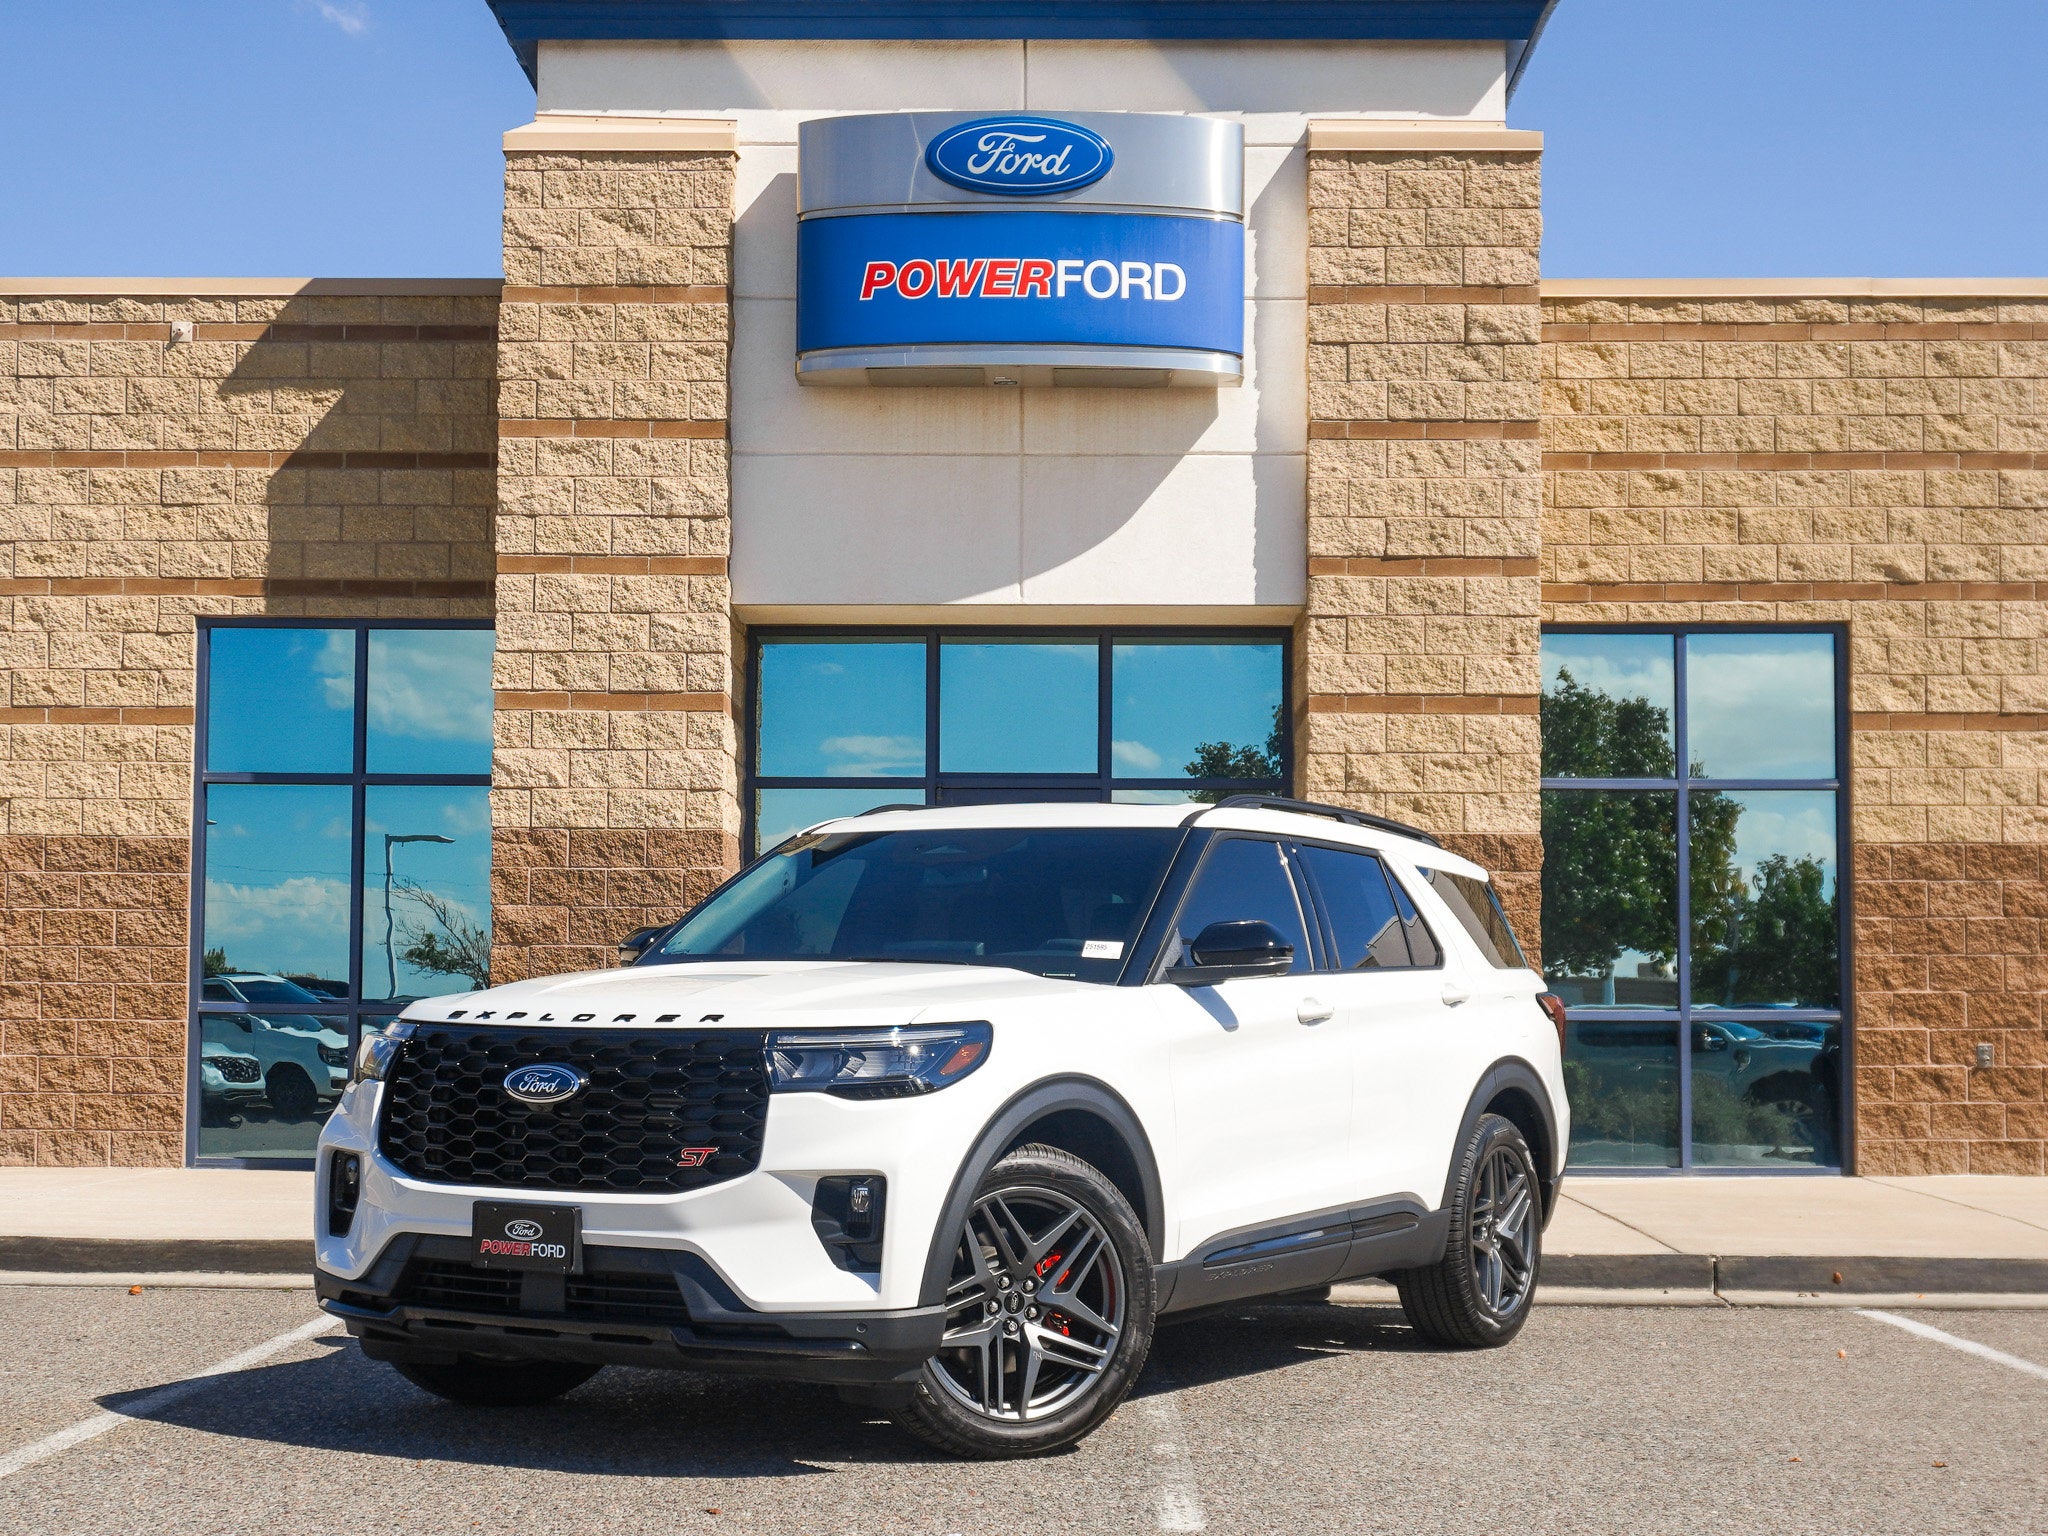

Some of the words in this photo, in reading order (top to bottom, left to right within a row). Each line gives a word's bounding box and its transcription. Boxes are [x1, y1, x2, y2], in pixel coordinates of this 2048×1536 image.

[967, 132, 1073, 175] Ford
[446, 1010, 725, 1023] EXPLORER
[518, 1072, 561, 1093] Ford
[677, 1147, 718, 1167] ST
[512, 1223, 536, 1236] Ford
